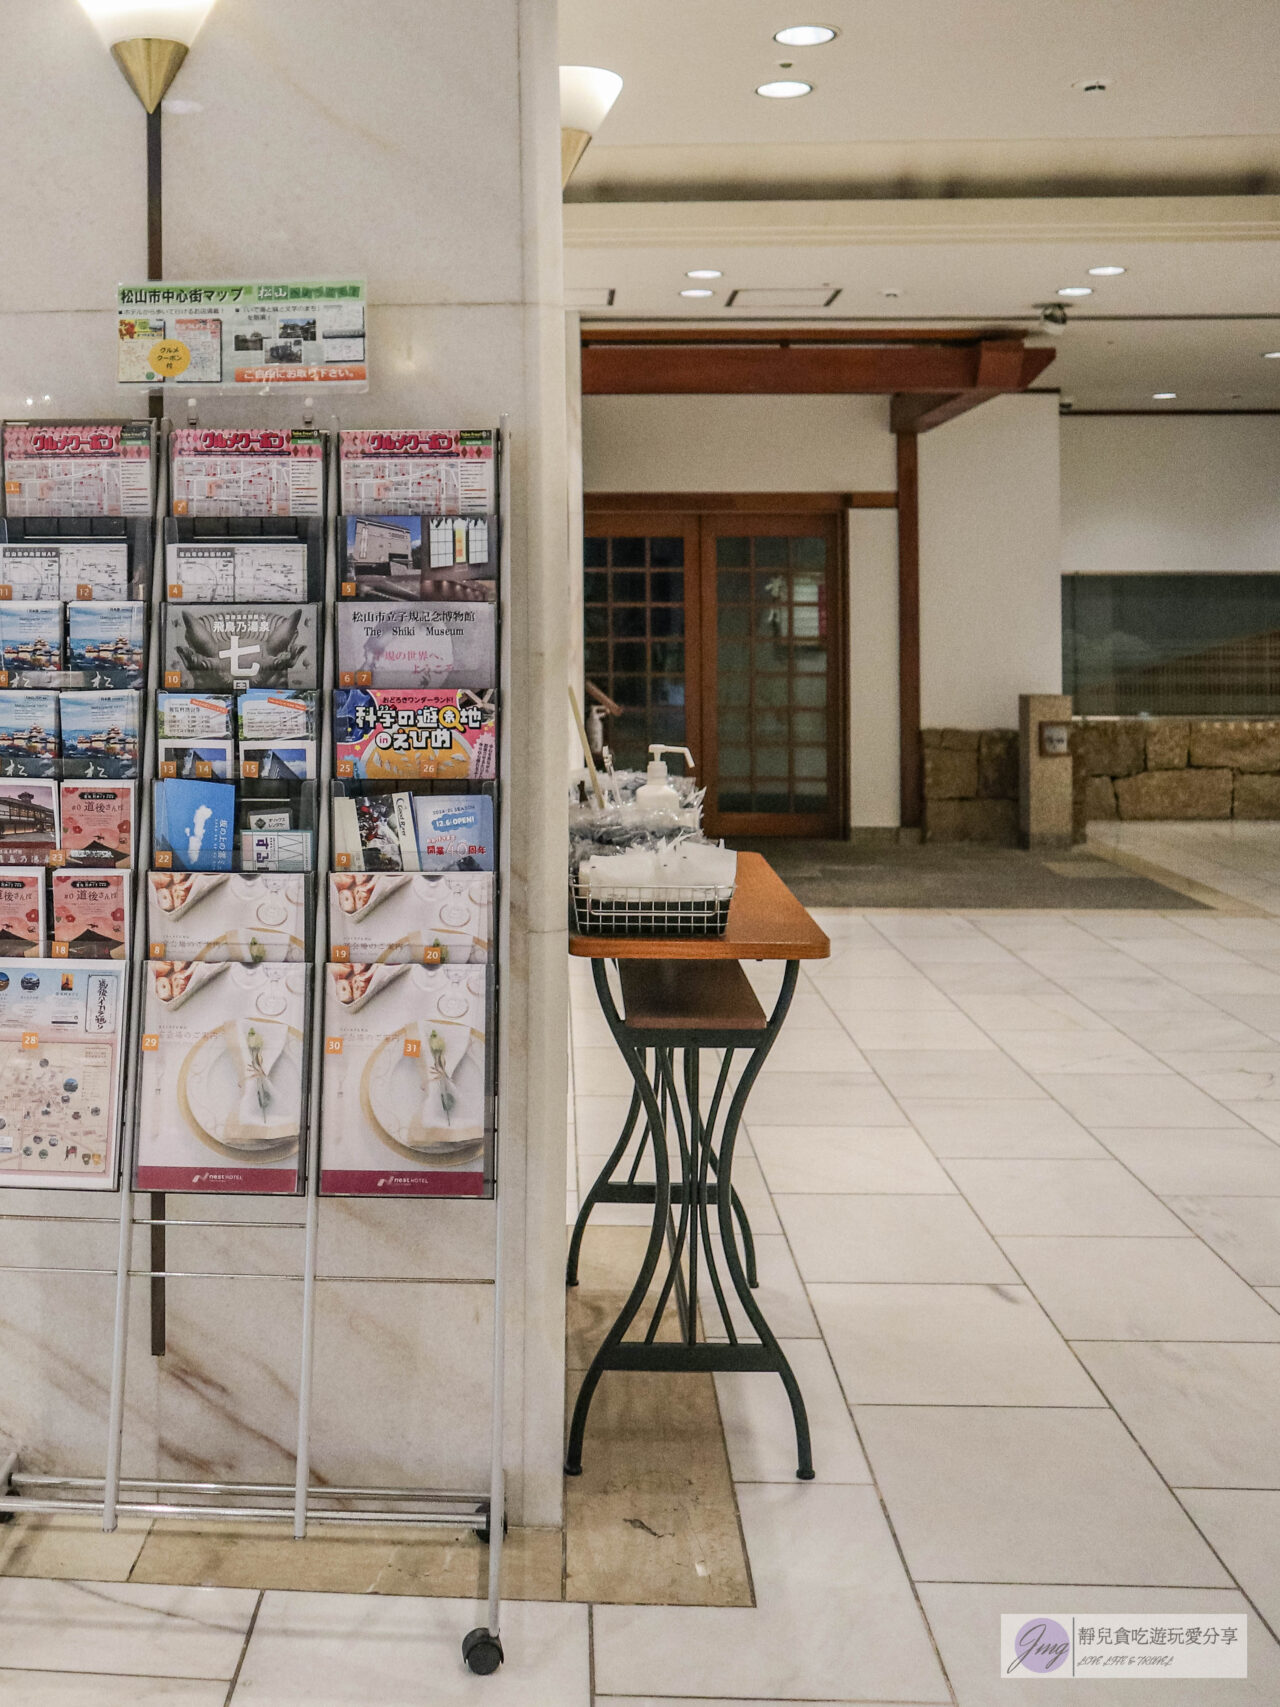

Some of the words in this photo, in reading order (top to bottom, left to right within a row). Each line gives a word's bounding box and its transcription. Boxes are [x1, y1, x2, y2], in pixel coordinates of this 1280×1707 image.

[121, 287, 244, 304] 松山市中心街マップ
[32, 433, 114, 451] グルメクーポン
[201, 431, 285, 449] グルメクーポン
[370, 433, 453, 451] グルメクーポン
[352, 611, 475, 623] 松山市立子規記念博物館
[364, 627, 382, 636] The
[392, 627, 415, 636] Shiki
[426, 627, 464, 636] Museum
[379, 735, 389, 744] in
